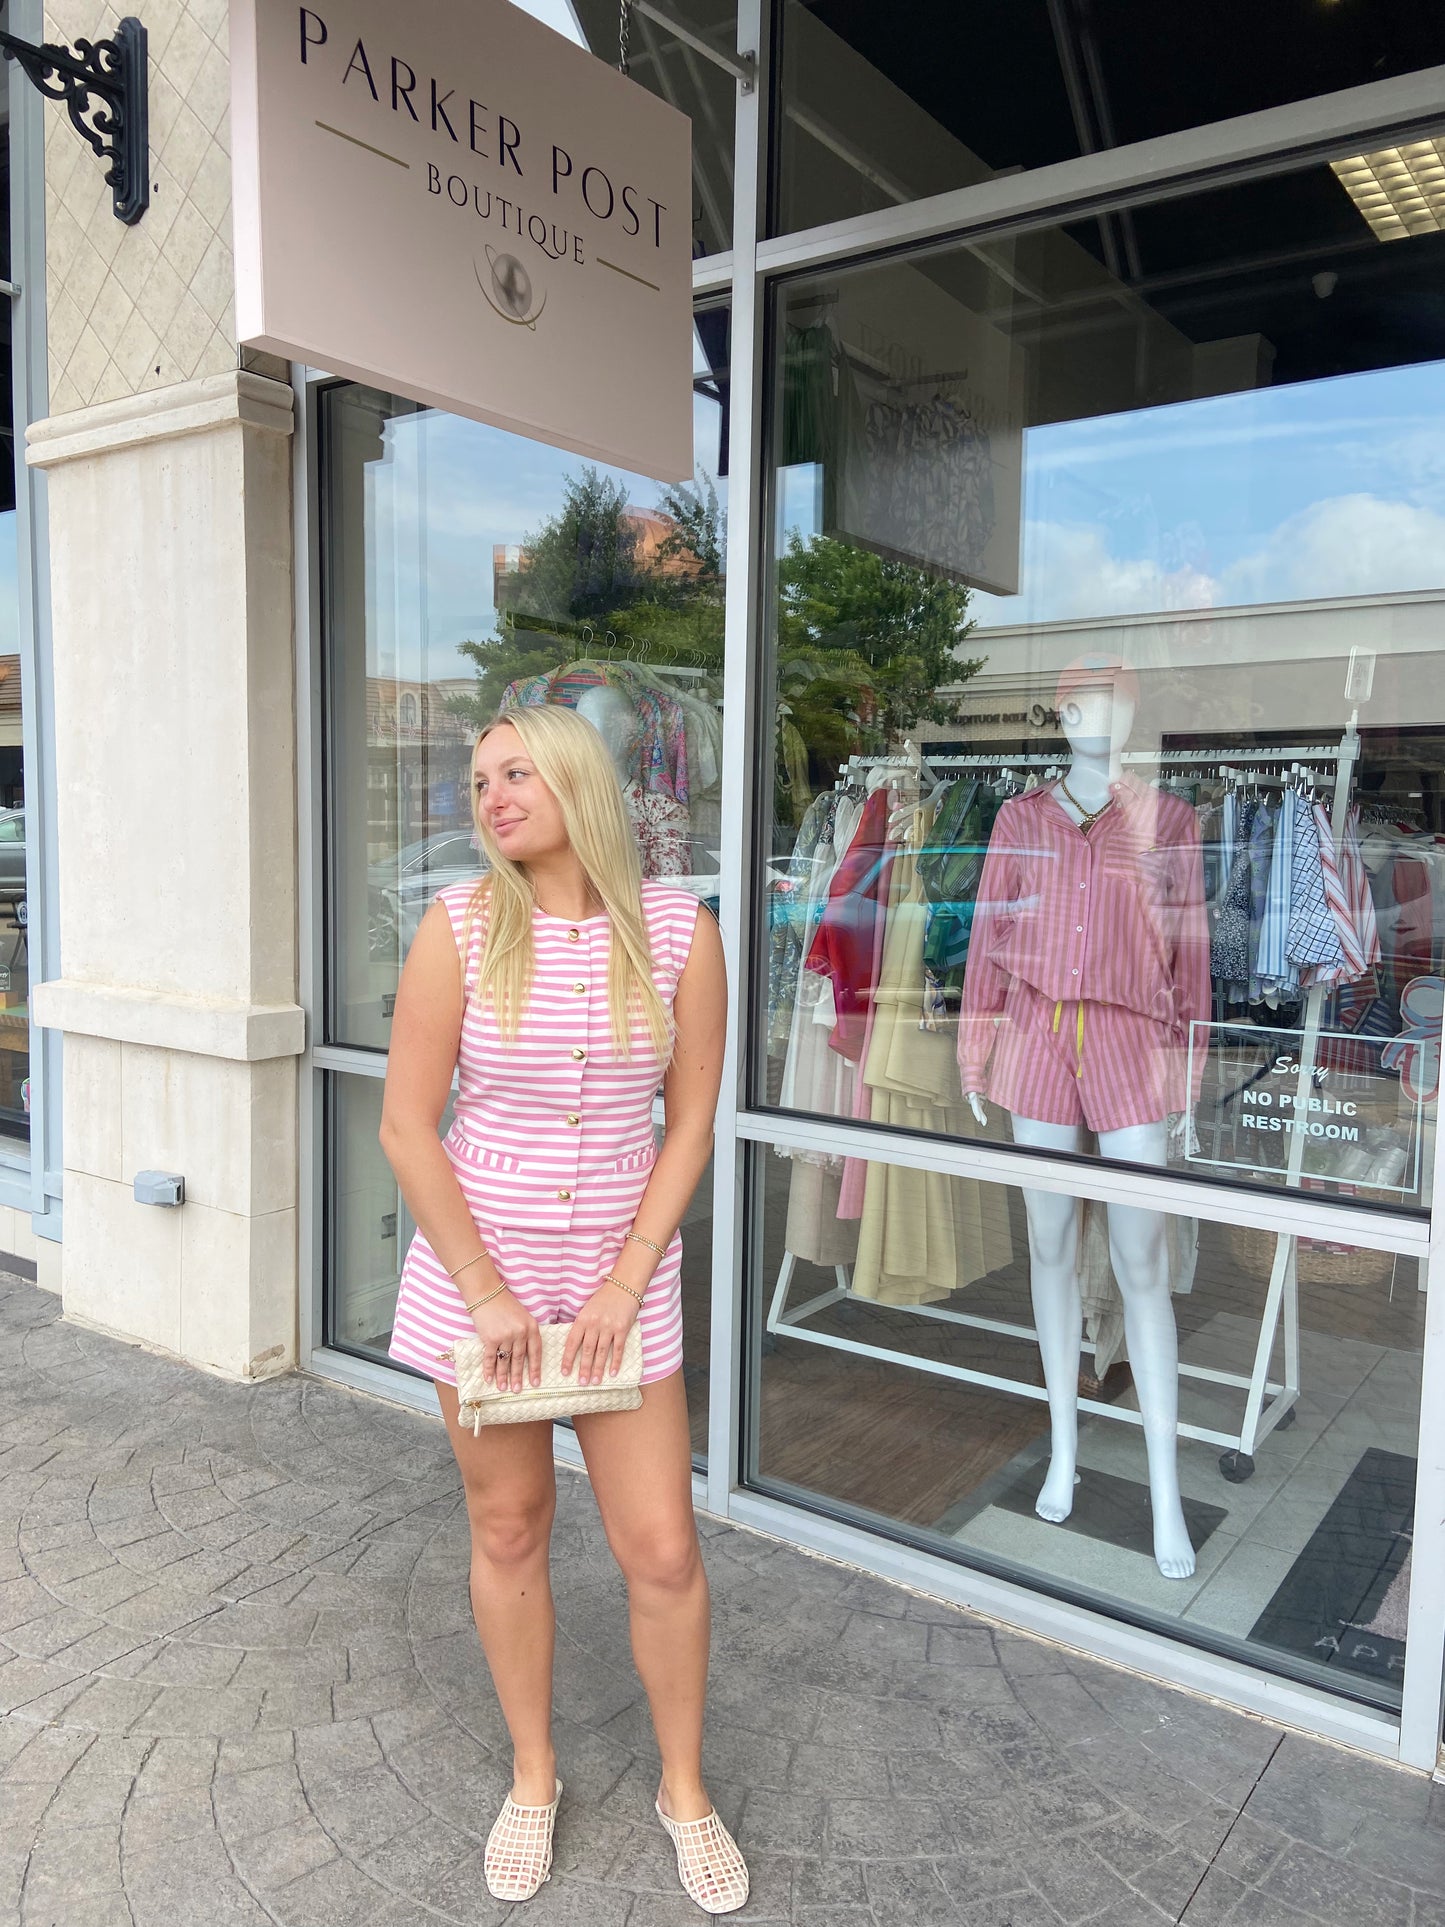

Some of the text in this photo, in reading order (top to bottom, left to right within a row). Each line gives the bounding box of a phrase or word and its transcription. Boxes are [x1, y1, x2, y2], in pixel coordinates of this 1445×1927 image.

[299, 6, 668, 248] PARKER POST
[426, 161, 586, 266] BOUTIQUE
[1271, 1055, 1329, 1083] Sorry
[1243, 1090, 1357, 1117] NO PUBLIC
[1242, 1113, 1359, 1142] RESTROOM
